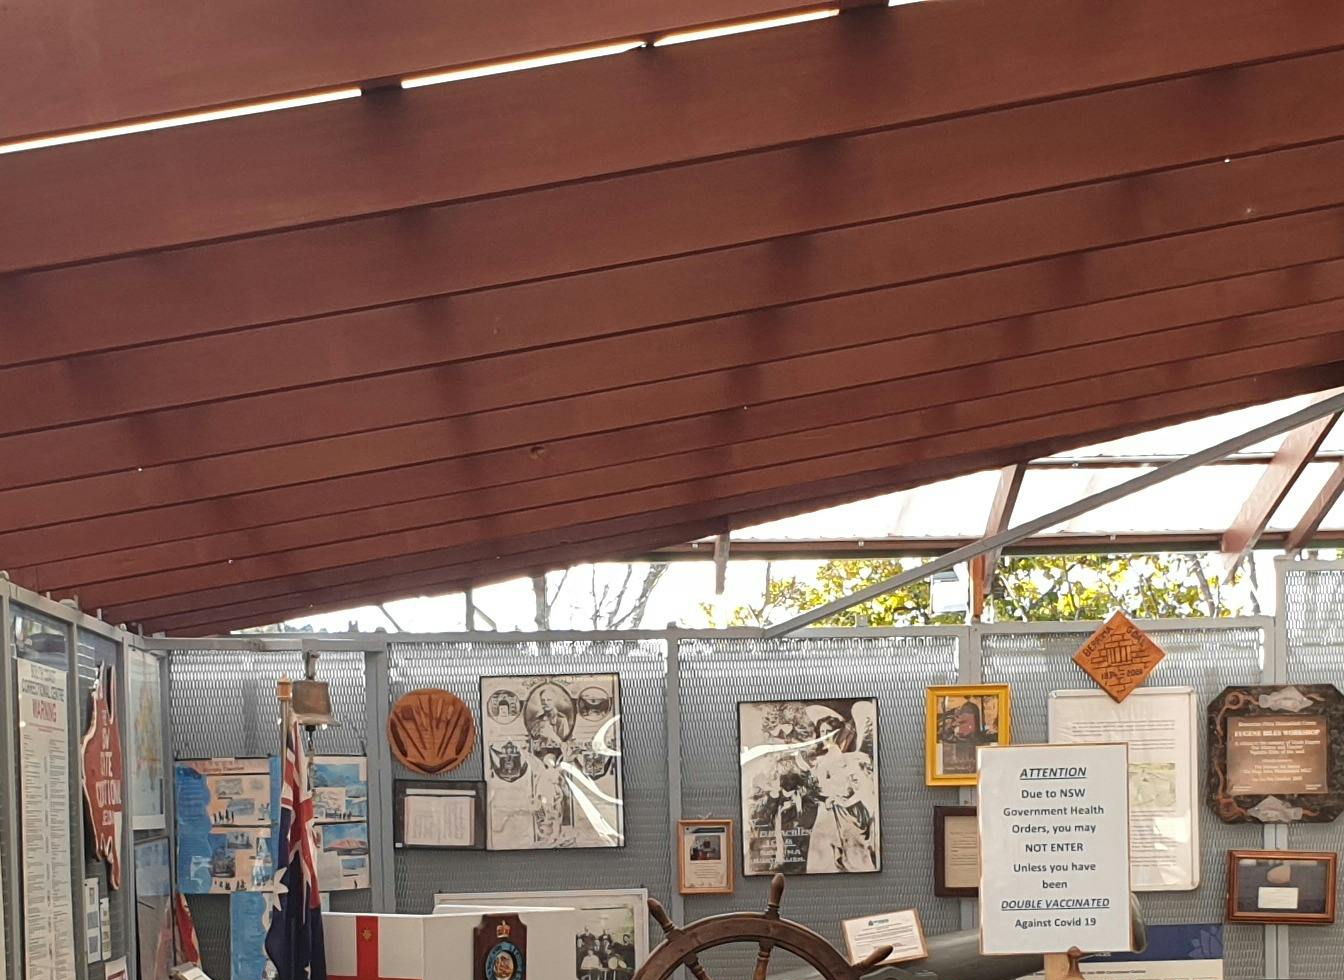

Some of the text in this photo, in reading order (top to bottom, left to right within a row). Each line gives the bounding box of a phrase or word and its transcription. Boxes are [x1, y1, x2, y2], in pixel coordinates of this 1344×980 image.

[32, 698, 57, 723] WARNING
[1020, 767, 1087, 779] ATTENTION
[1022, 788, 1086, 799] Due to NSW
[1003, 805, 1105, 817] Government Health
[1012, 824, 1097, 835] Orders, you may
[1026, 843, 1084, 853] NOT ENTER
[1014, 862, 1097, 874] Unless you have
[1043, 880, 1068, 889] been
[1001, 898, 1110, 909] DOUBLE VACCINATED
[1015, 917, 1097, 930] Against Covid 19
